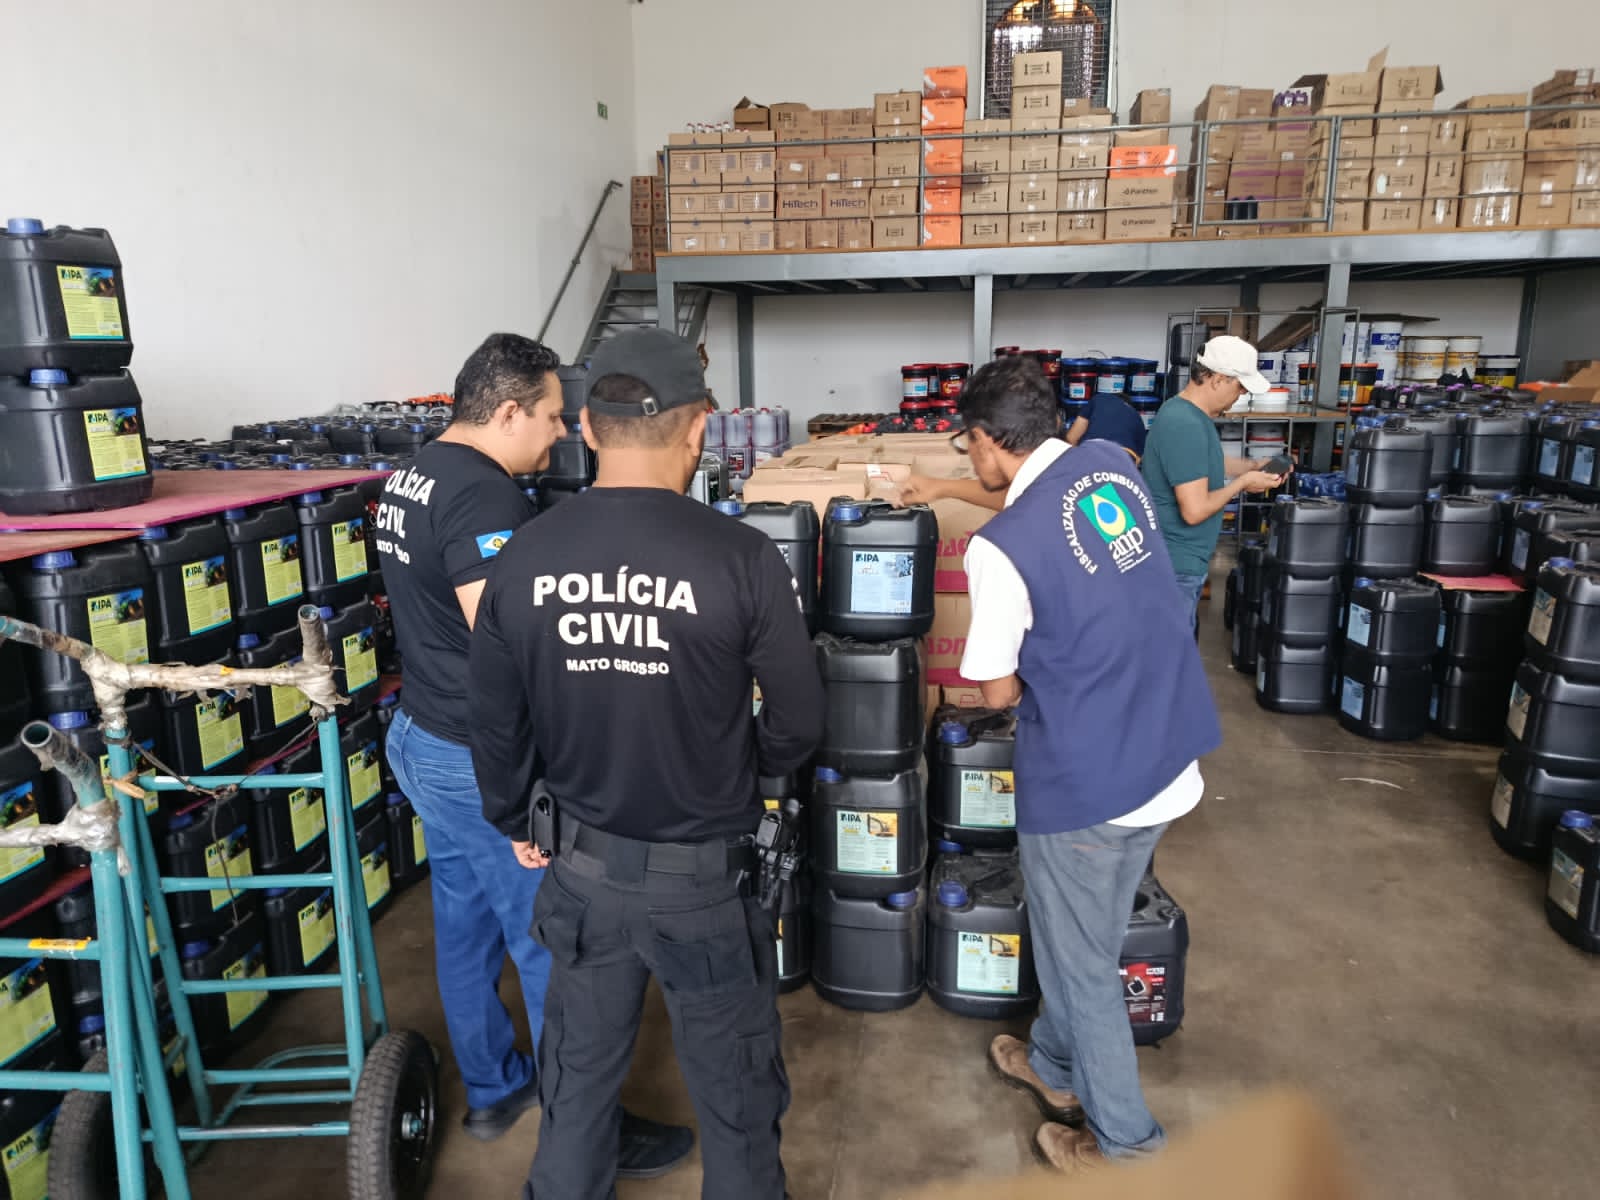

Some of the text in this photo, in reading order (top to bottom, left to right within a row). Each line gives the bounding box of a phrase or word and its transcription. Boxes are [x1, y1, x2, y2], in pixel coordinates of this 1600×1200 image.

[385, 466, 435, 505] OLÍCIA
[1074, 476, 1092, 492] DE
[1109, 527, 1143, 560] anp
[533, 565, 698, 615] POLÍCIA
[558, 612, 669, 651] CIVIL
[566, 658, 669, 675] MATO GROSSO
